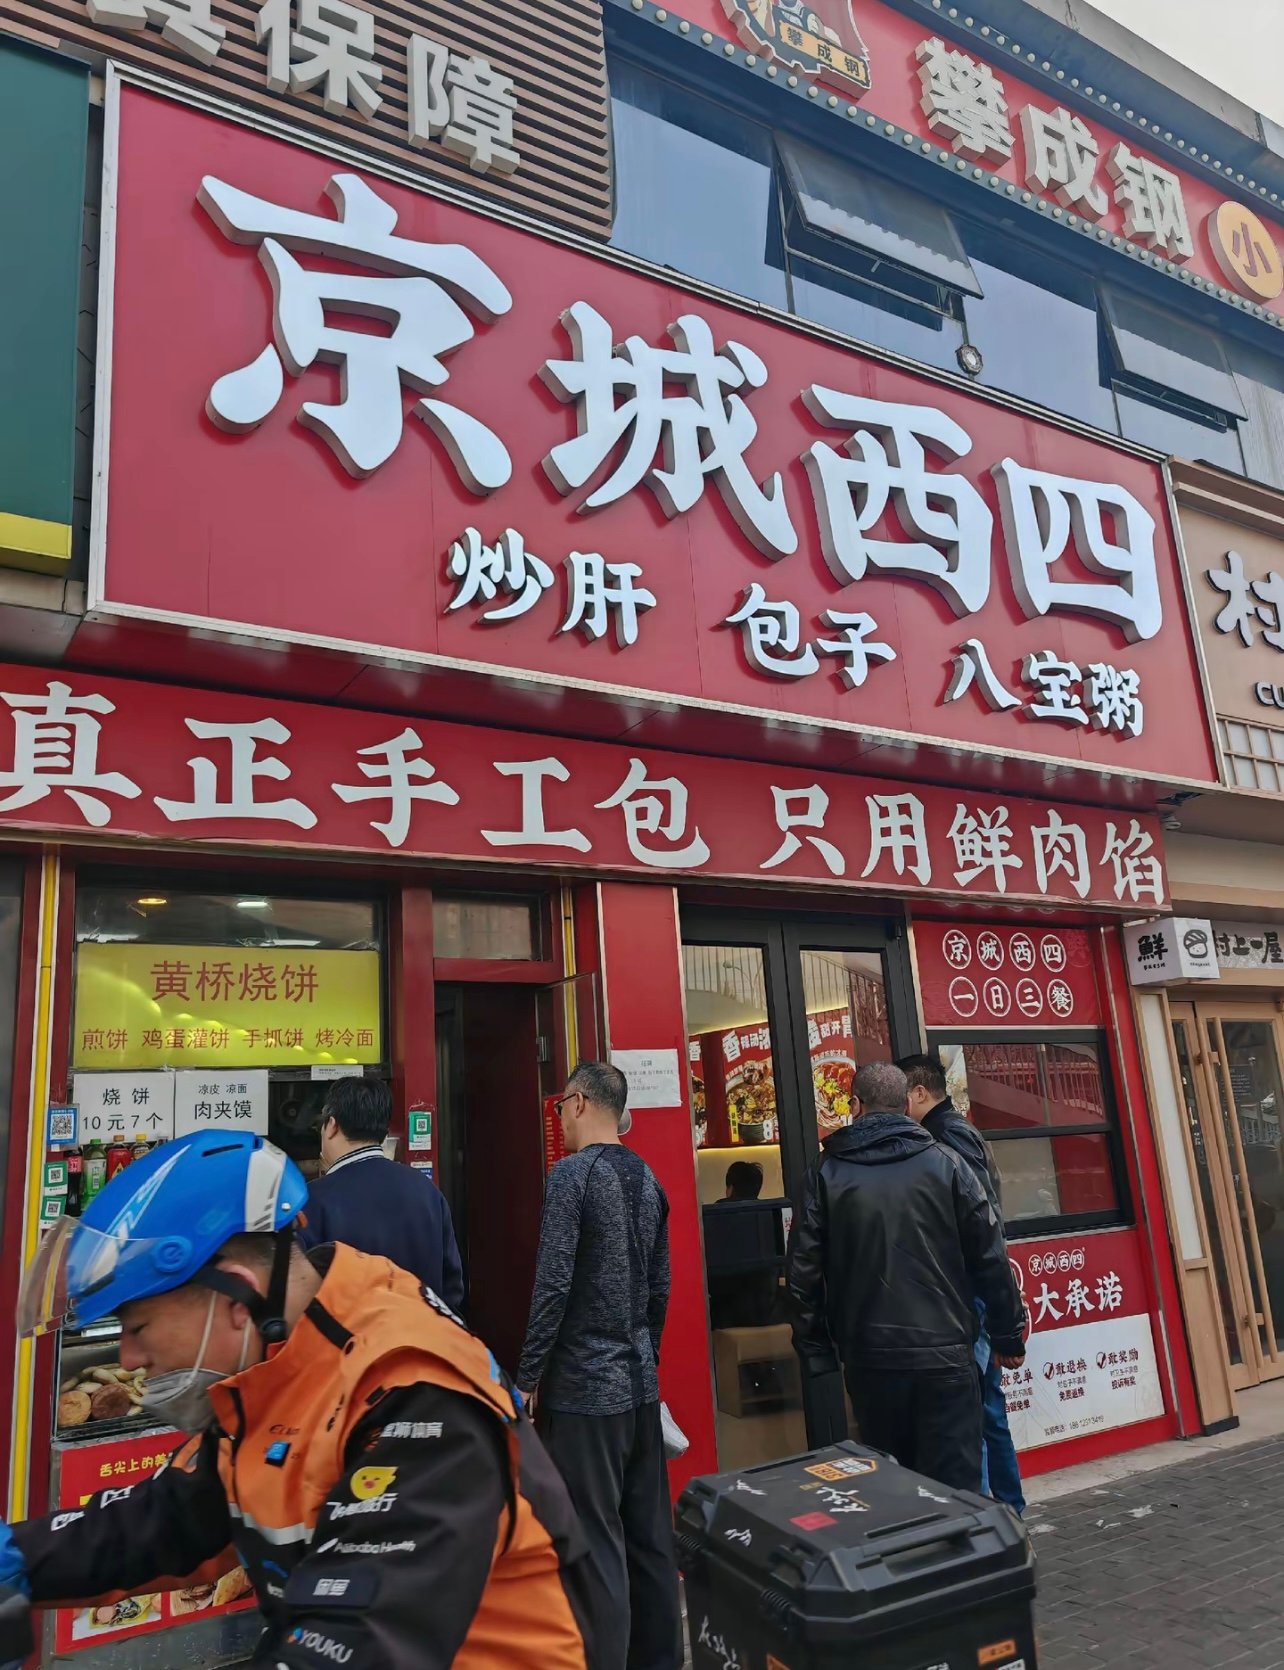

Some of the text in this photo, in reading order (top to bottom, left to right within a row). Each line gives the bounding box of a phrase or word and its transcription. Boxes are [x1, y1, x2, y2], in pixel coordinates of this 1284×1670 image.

[915, 35, 1273, 278] 攀成钢 小
[196, 172, 1163, 642] 京城西四
[443, 526, 1144, 738] 炒肝 包子 八宝粥
[0, 680, 1166, 905] 真正手工包 只用鲜肉馅
[947, 934, 1064, 966] 京城西四
[150, 960, 319, 1004] 黄桥烧饼
[952, 984, 1070, 1012] 一日三餐
[81, 1028, 375, 1050] 煎饼 鸡蛋灌饼 手抓饼 烤冷面
[102, 1087, 150, 1107] 烧饼
[198, 1083, 248, 1096] 凉皮 凉面
[194, 1100, 252, 1120] 肉夹馍
[1030, 1250, 1084, 1276] 京城西四
[1033, 1271, 1124, 1324] 大承诺
[300, 1628, 354, 1664] YOUKU
